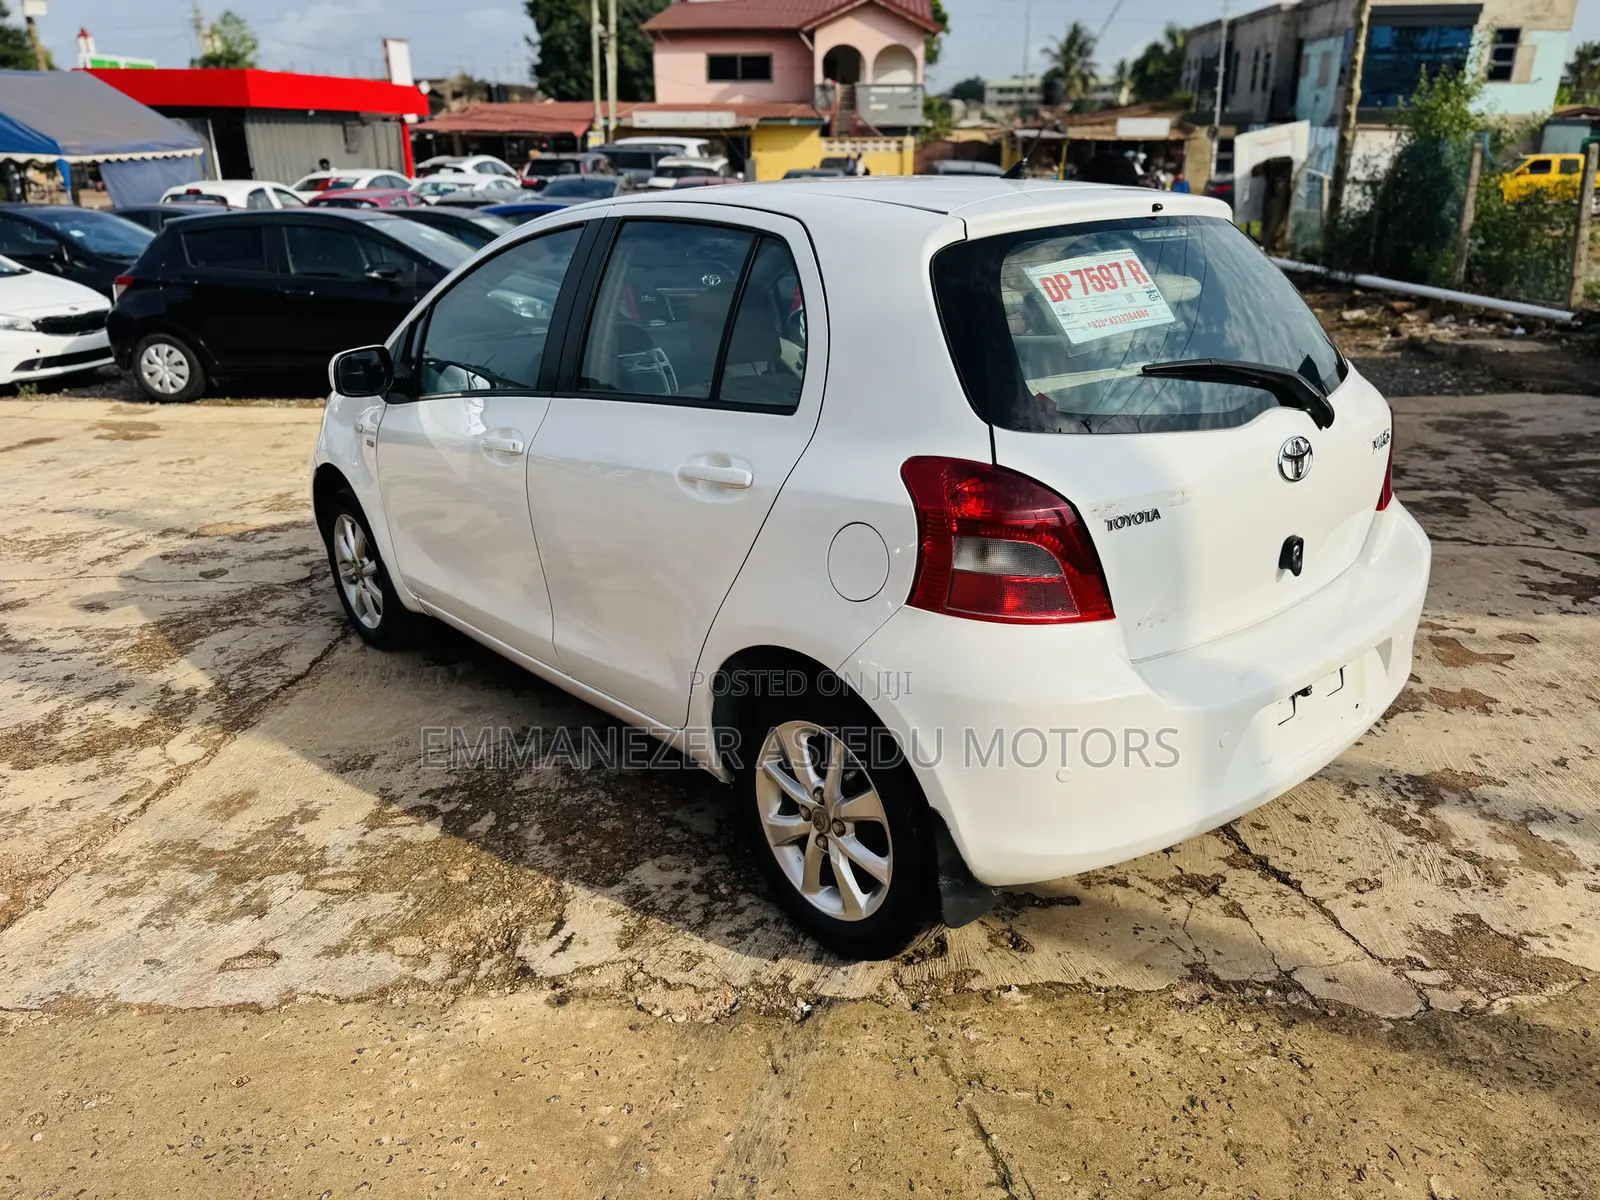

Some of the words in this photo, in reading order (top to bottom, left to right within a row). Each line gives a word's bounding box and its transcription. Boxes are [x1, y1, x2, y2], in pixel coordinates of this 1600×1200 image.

[1039, 274, 1073, 303] DP
[1069, 262, 1128, 296] 7597
[1124, 259, 1150, 285] R
[1148, 292, 1163, 302] GH
[1105, 508, 1161, 532] TOYOTA
